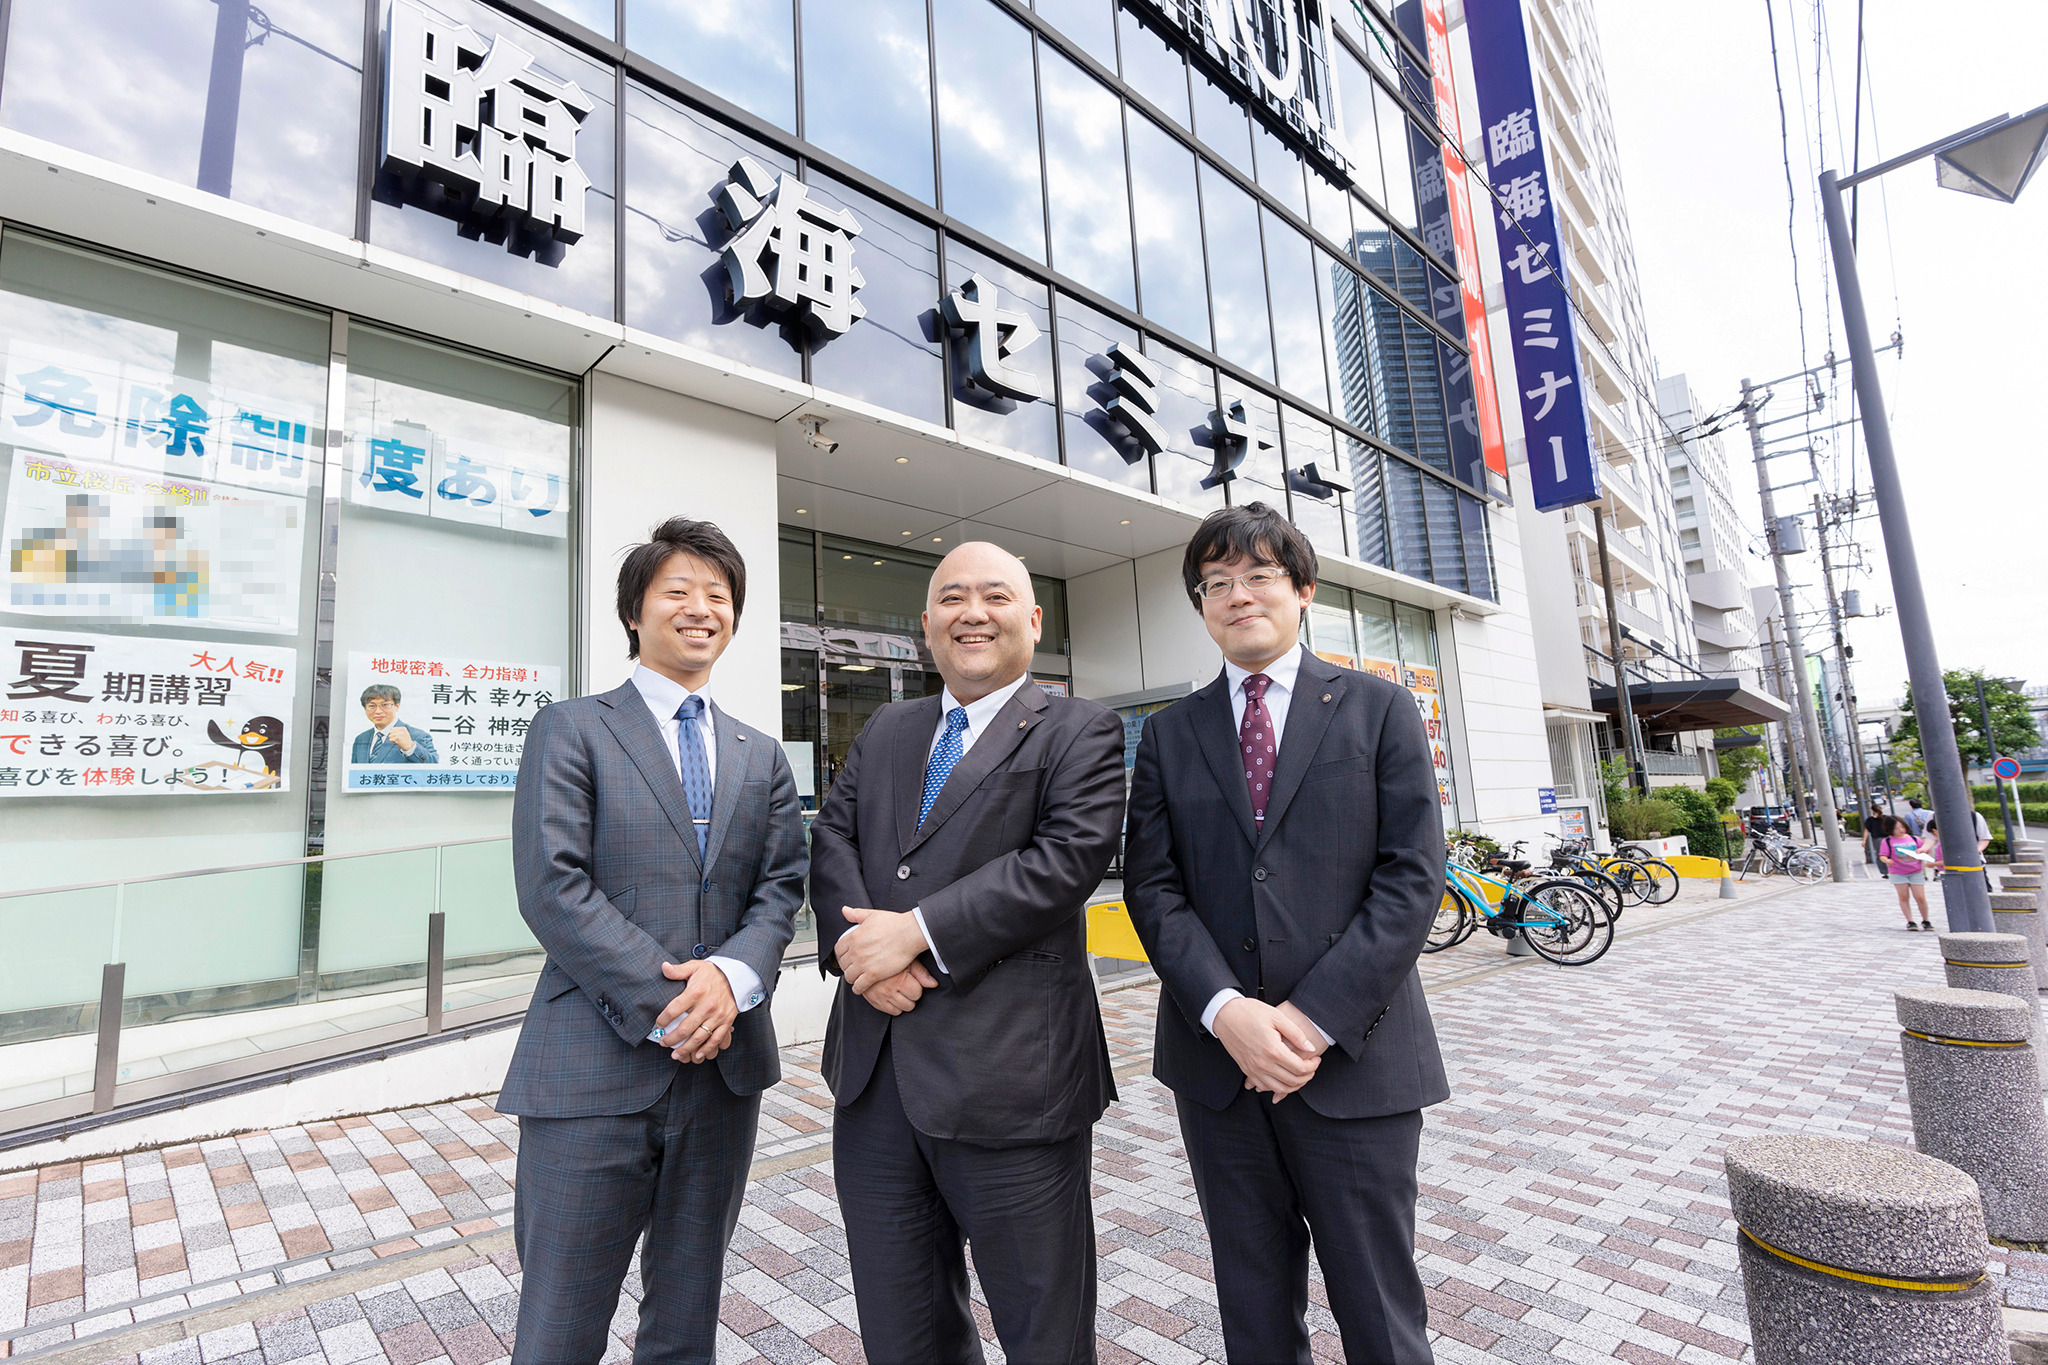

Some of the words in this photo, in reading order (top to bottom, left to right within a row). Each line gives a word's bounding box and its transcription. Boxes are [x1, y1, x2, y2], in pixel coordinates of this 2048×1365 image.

[382, 0, 1354, 493] 臨海セミナー
[1488, 107, 1573, 484] 臨海セミナー
[7, 640, 232, 707] 夏期講習
[431, 684, 477, 706] 青木
[0, 733, 183, 758] できる喜び。
[429, 715, 476, 736] 二谷
